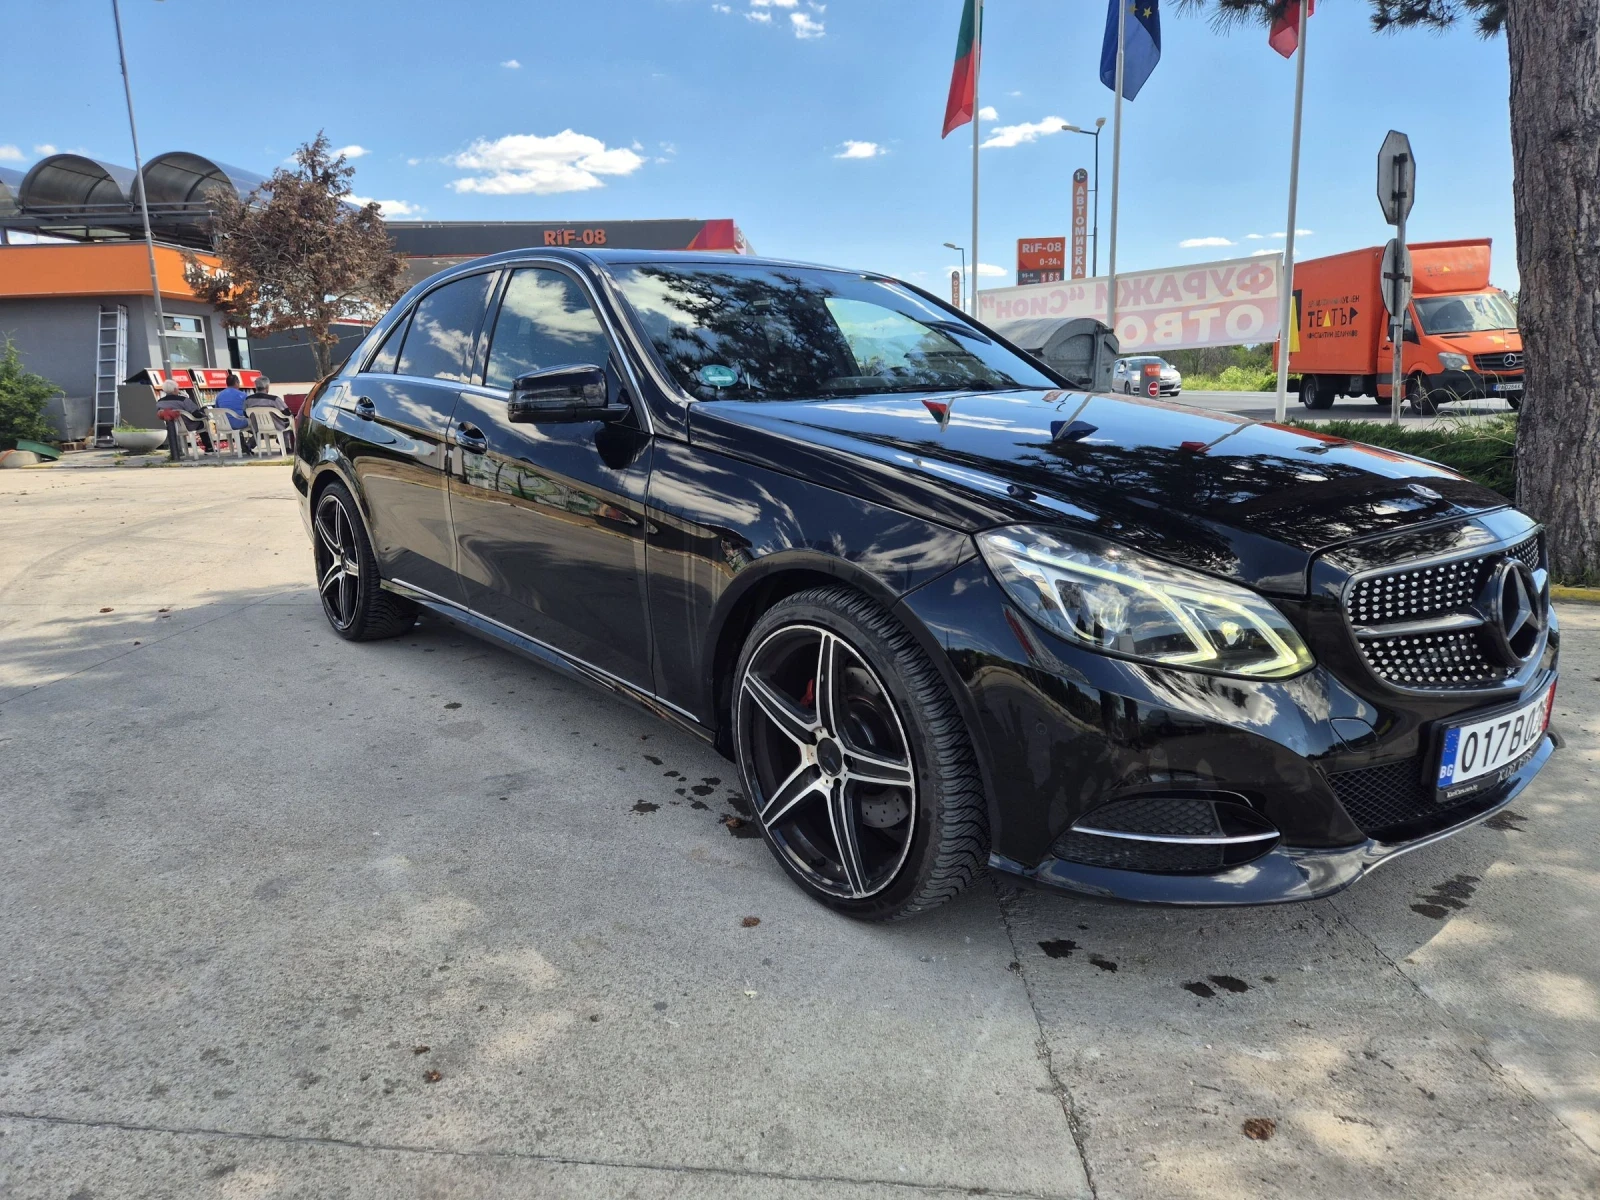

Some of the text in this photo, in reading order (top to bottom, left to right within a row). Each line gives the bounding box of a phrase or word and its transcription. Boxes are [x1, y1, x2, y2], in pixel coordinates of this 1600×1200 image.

[543, 228, 607, 245] RiF-08
[1074, 186, 1085, 275] АВТОМИВКА
[1022, 242, 1062, 254] RiF-08
[1439, 764, 1454, 779] BG
